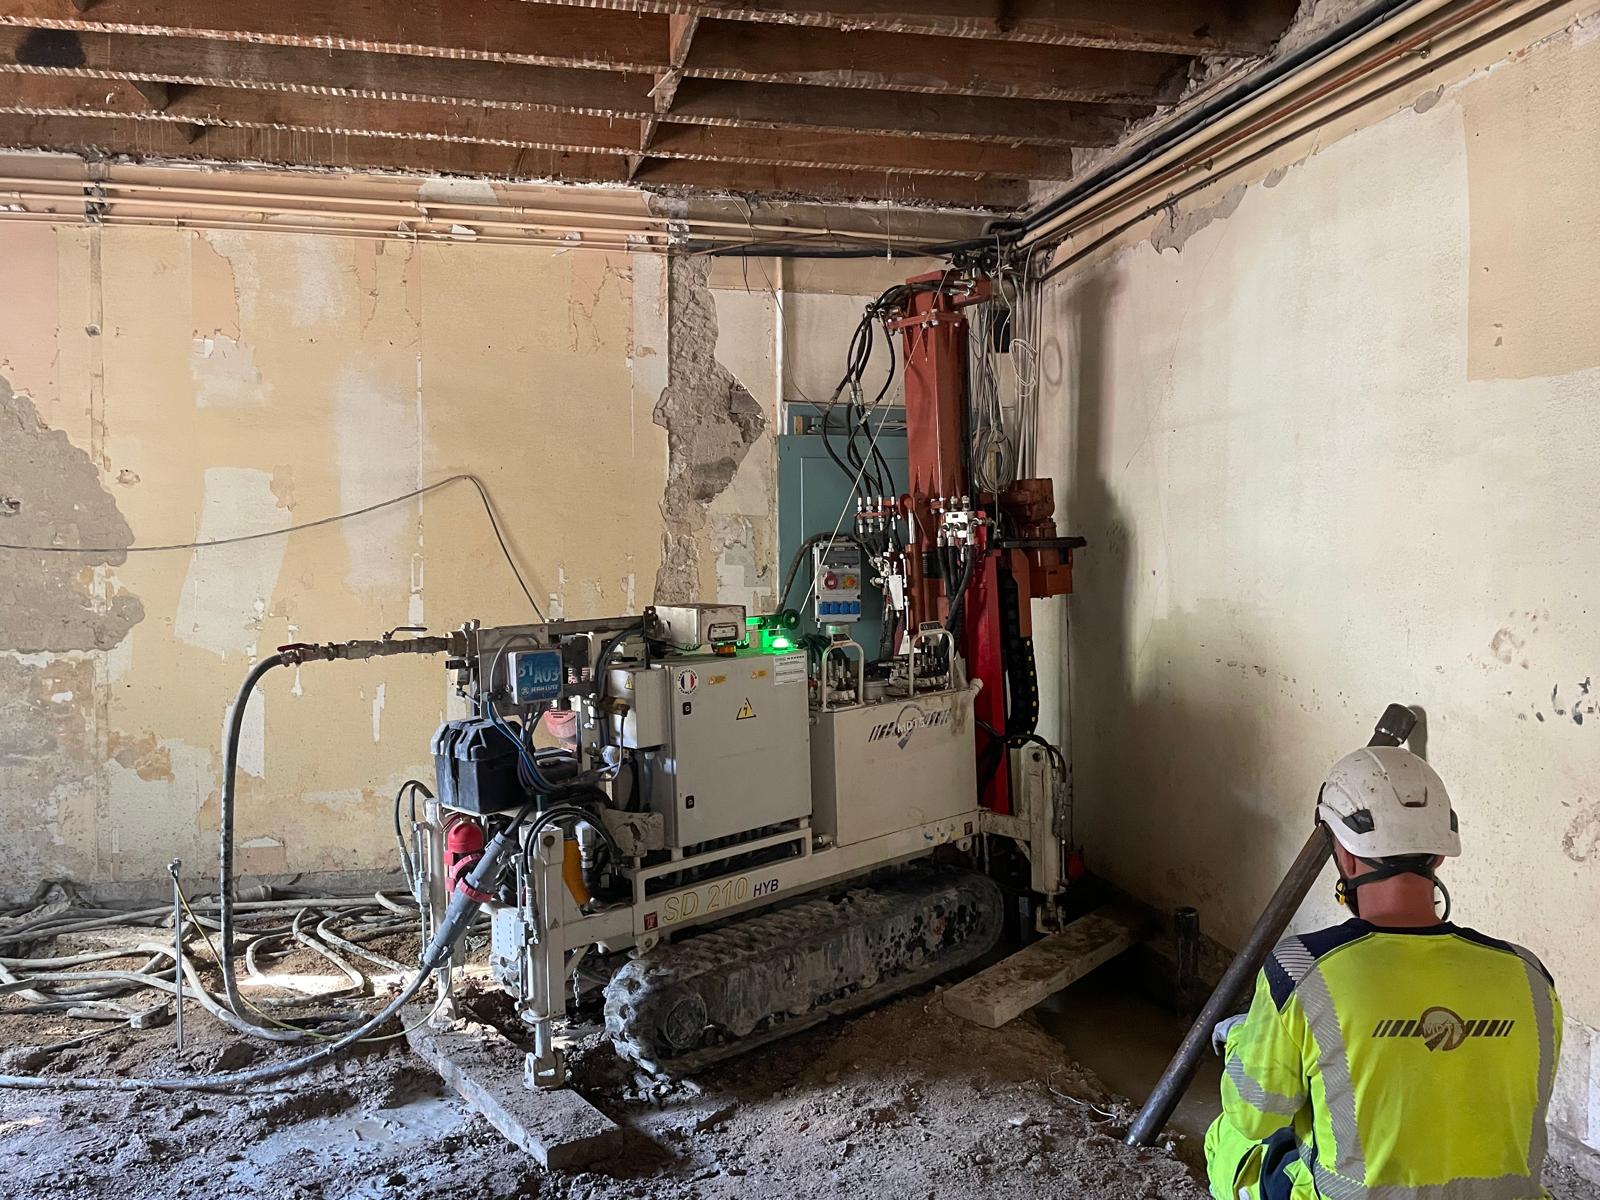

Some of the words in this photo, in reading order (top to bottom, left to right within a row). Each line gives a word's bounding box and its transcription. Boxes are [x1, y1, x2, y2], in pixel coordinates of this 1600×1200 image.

[662, 891, 699, 924] SD
[706, 877, 749, 913] 210
[753, 878, 779, 898] HYB
